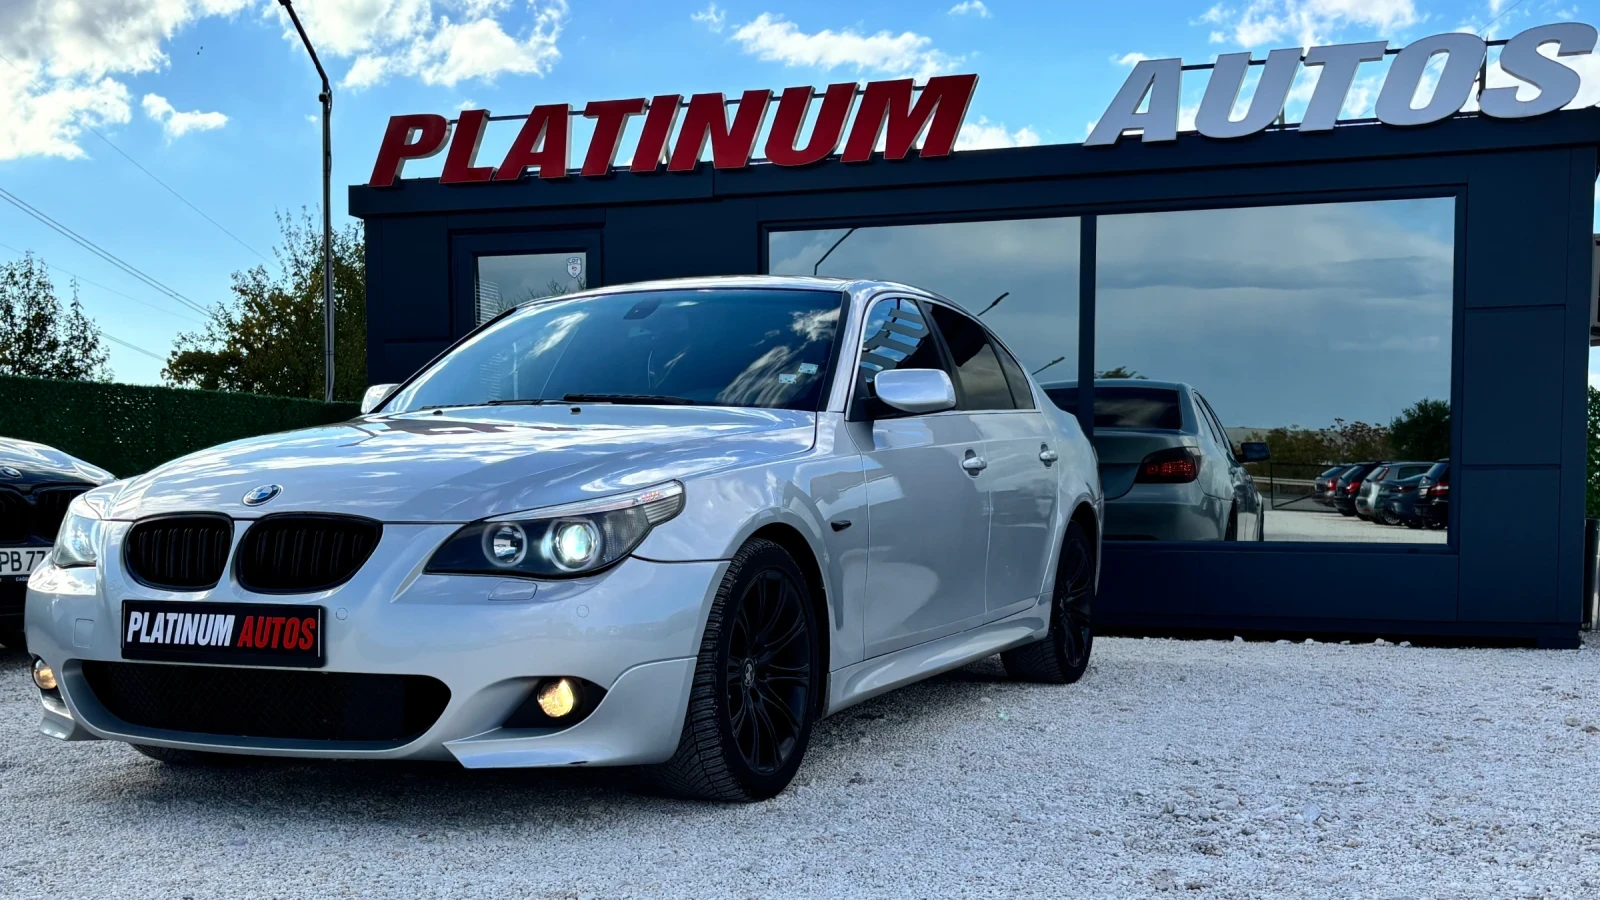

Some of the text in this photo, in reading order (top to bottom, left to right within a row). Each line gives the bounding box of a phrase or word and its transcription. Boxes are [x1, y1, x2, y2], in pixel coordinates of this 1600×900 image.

[368, 22, 1599, 188] PLATINUM AUTOS
[126, 611, 316, 650] PLATINUM AUTOS
